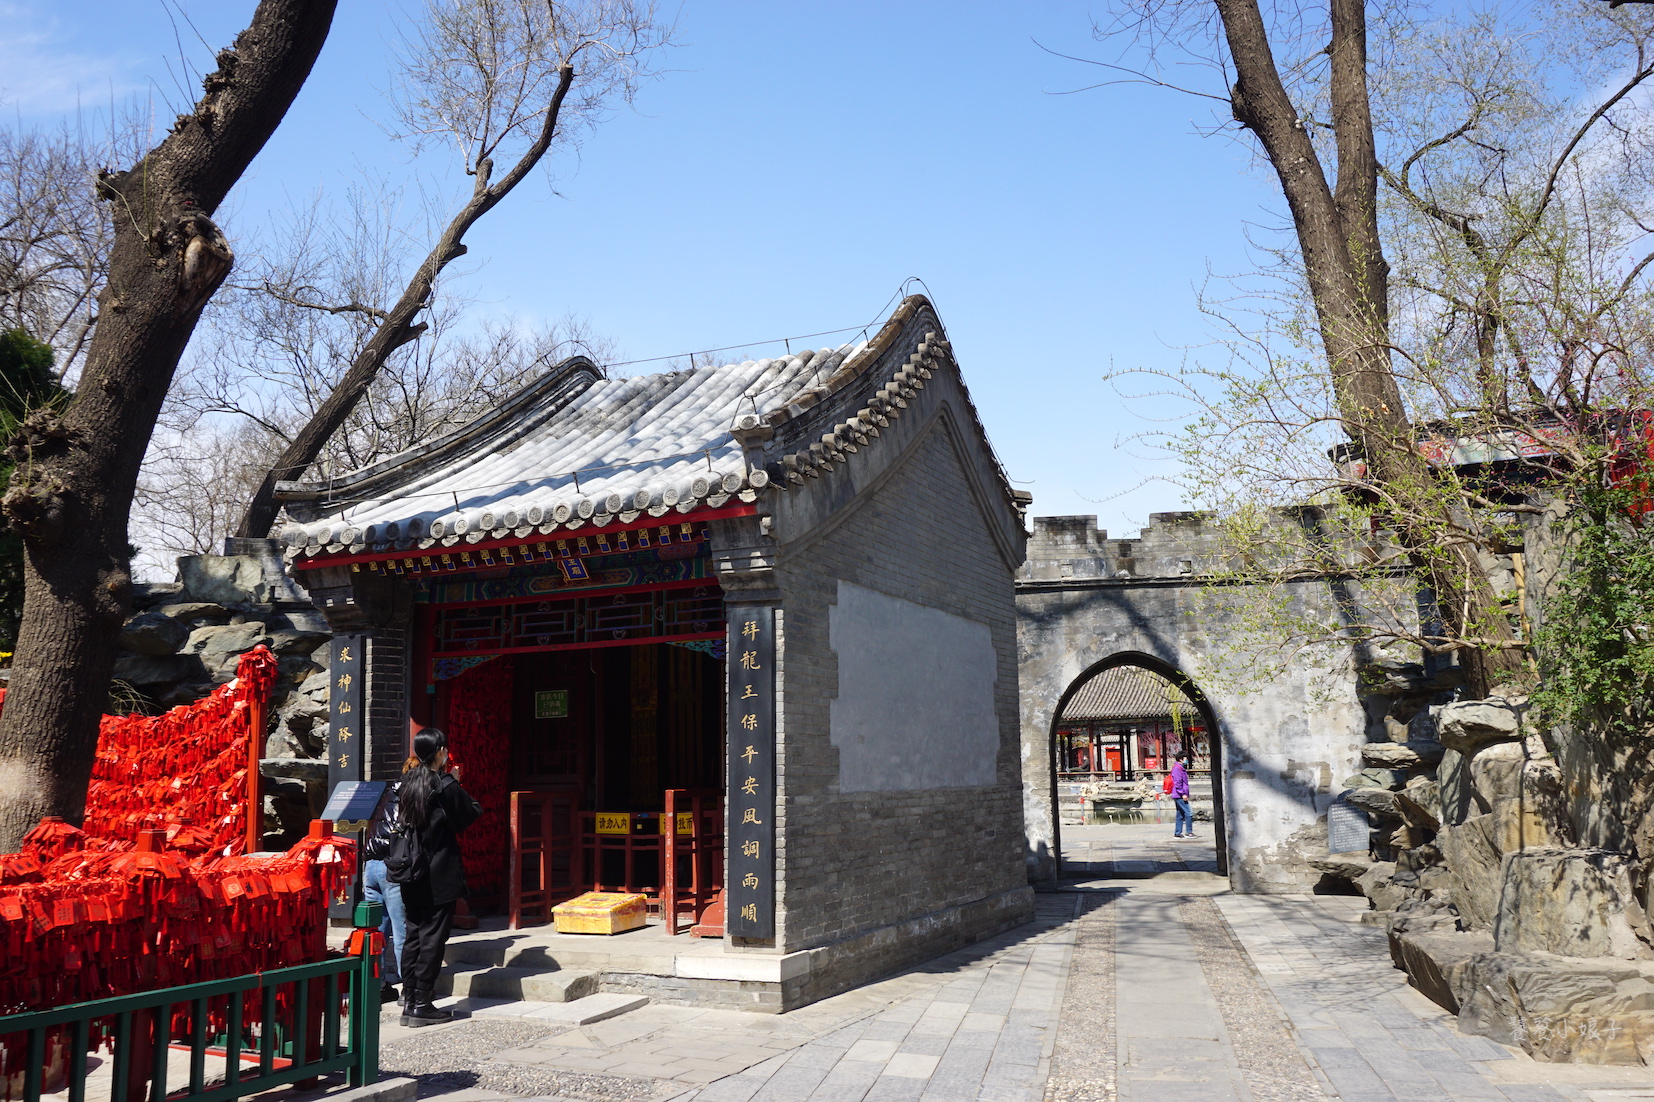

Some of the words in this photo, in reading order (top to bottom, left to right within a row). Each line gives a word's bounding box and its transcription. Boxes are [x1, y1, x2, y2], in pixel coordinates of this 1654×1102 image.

[739, 621, 762, 924] 拜龍王保平安風調雨順
[598, 817, 627, 830] 请勿入内
[663, 817, 693, 830] 投币
